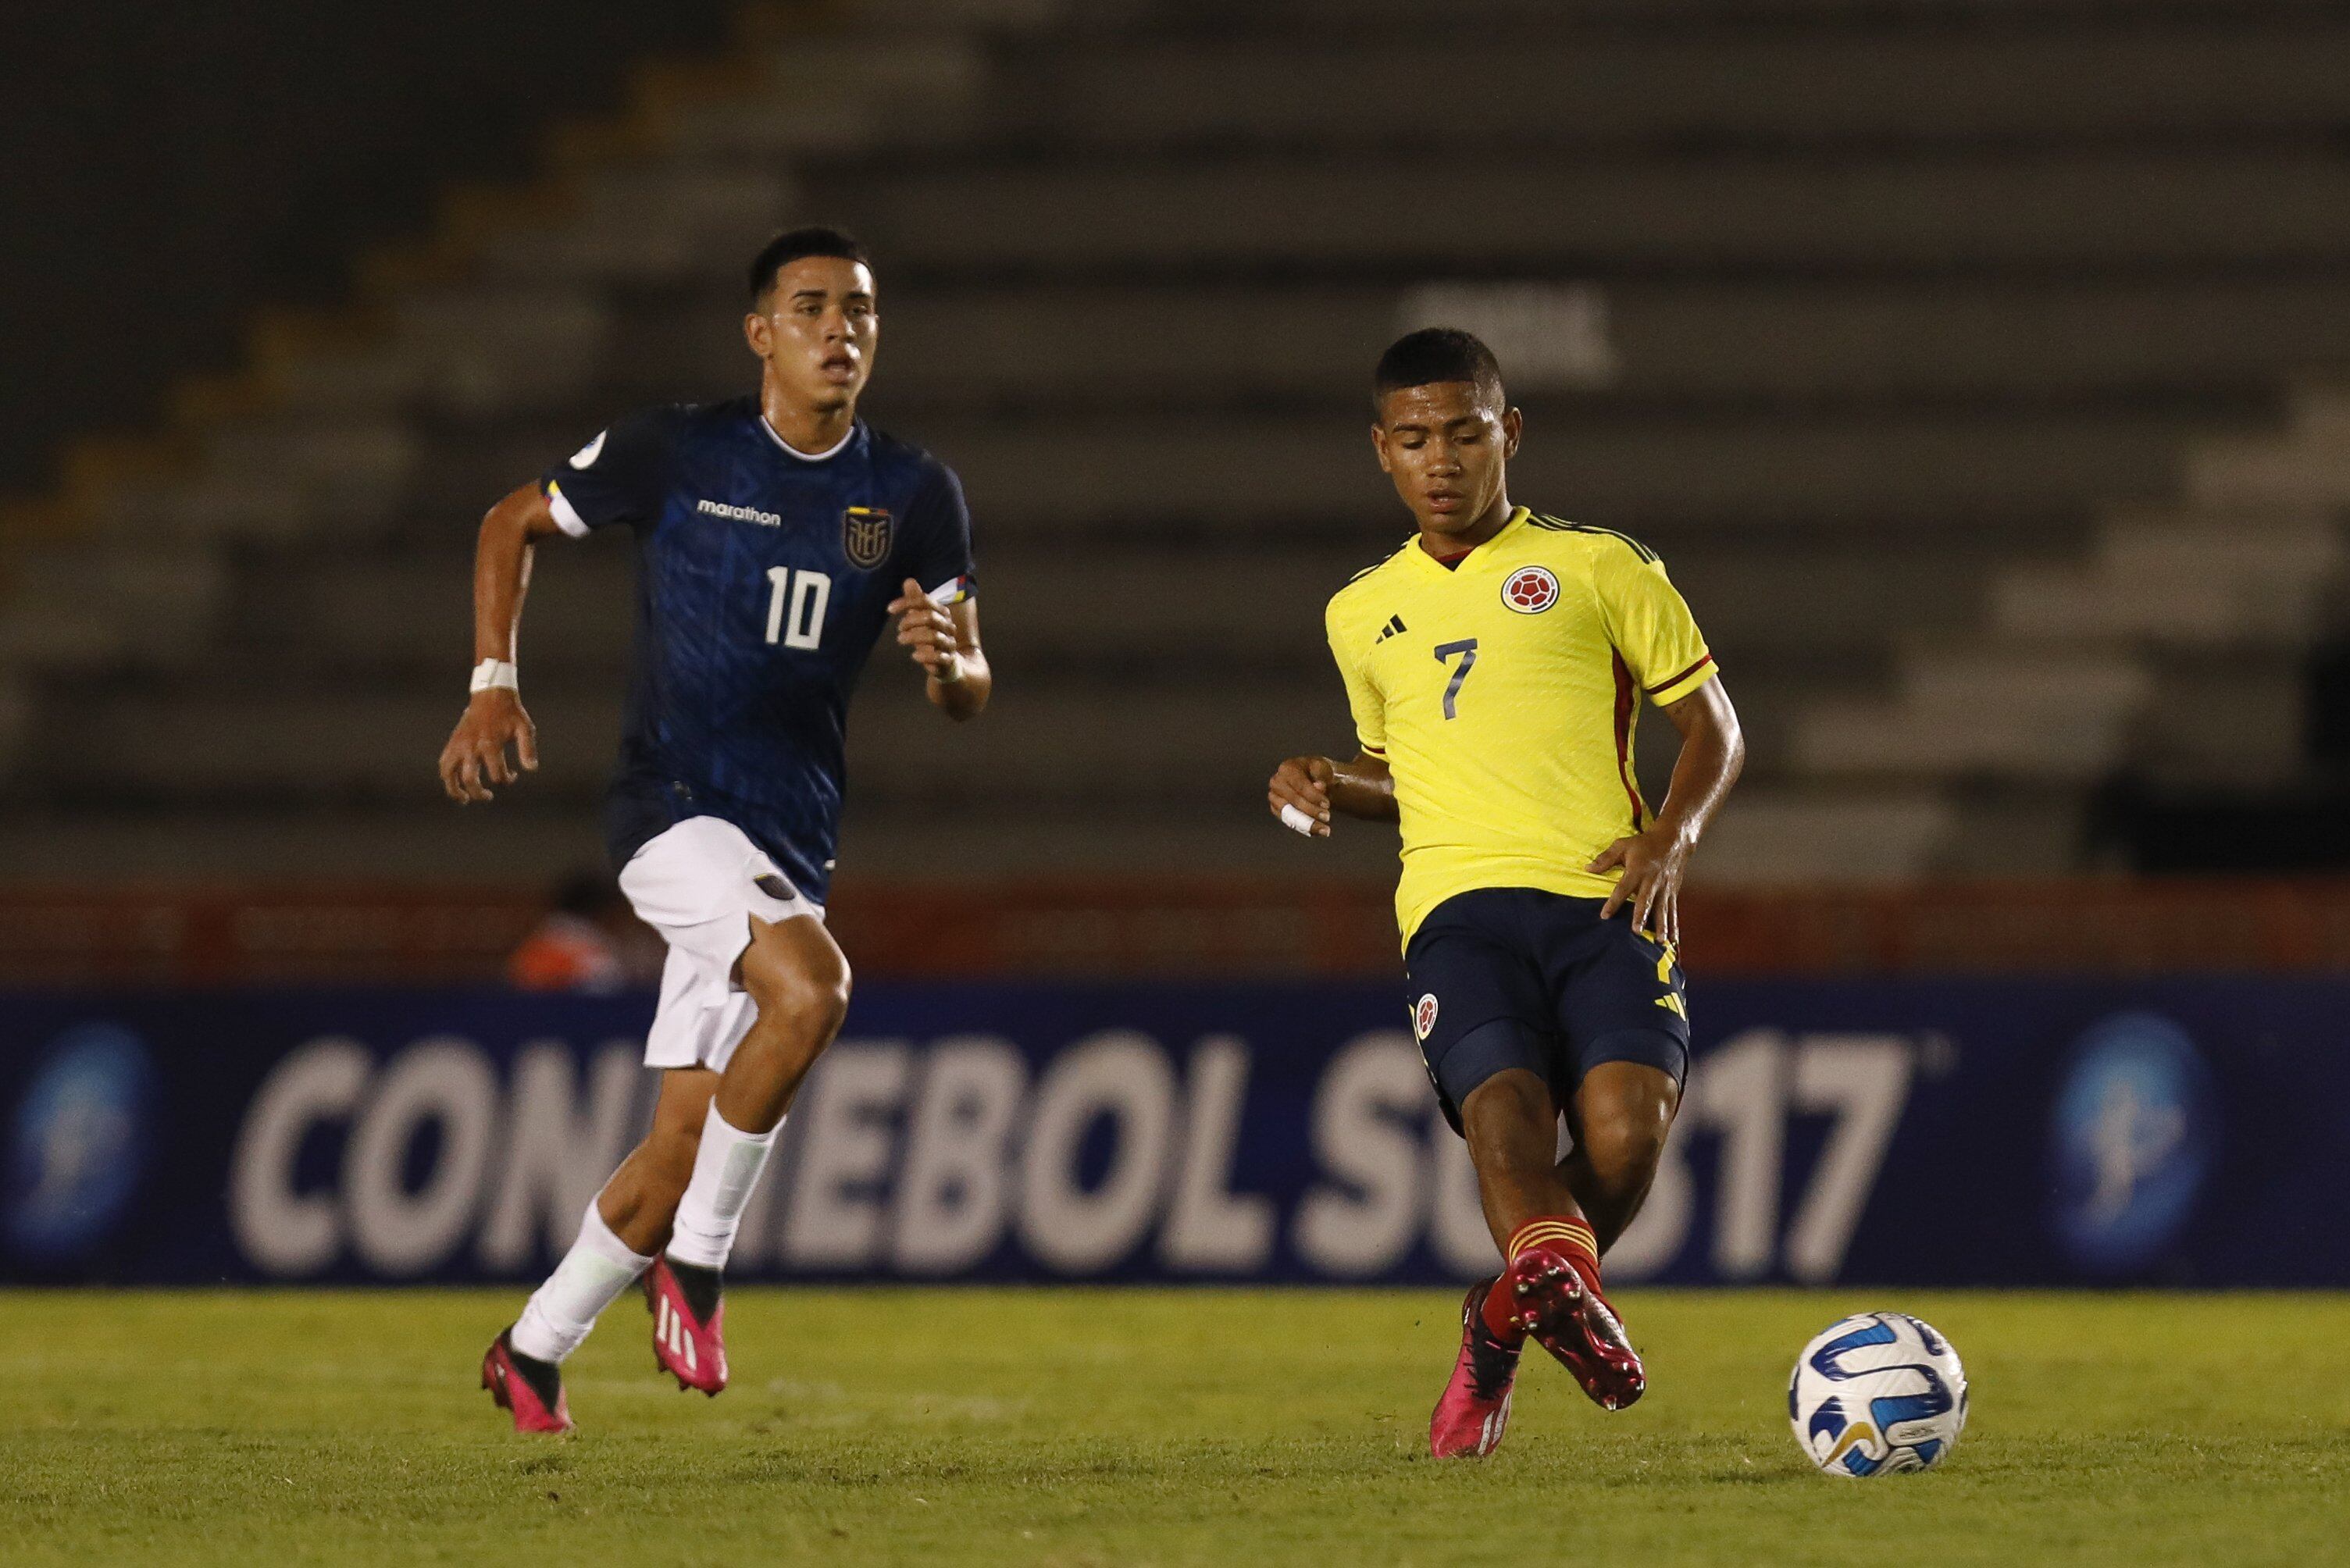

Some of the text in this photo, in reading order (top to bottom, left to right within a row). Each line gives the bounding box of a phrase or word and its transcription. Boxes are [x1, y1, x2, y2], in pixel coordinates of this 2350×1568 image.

[697, 499, 781, 527] marathon
[765, 565, 832, 651] 10
[1434, 637, 1478, 720] 7
[230, 1029, 1278, 1278] CONEBOL
